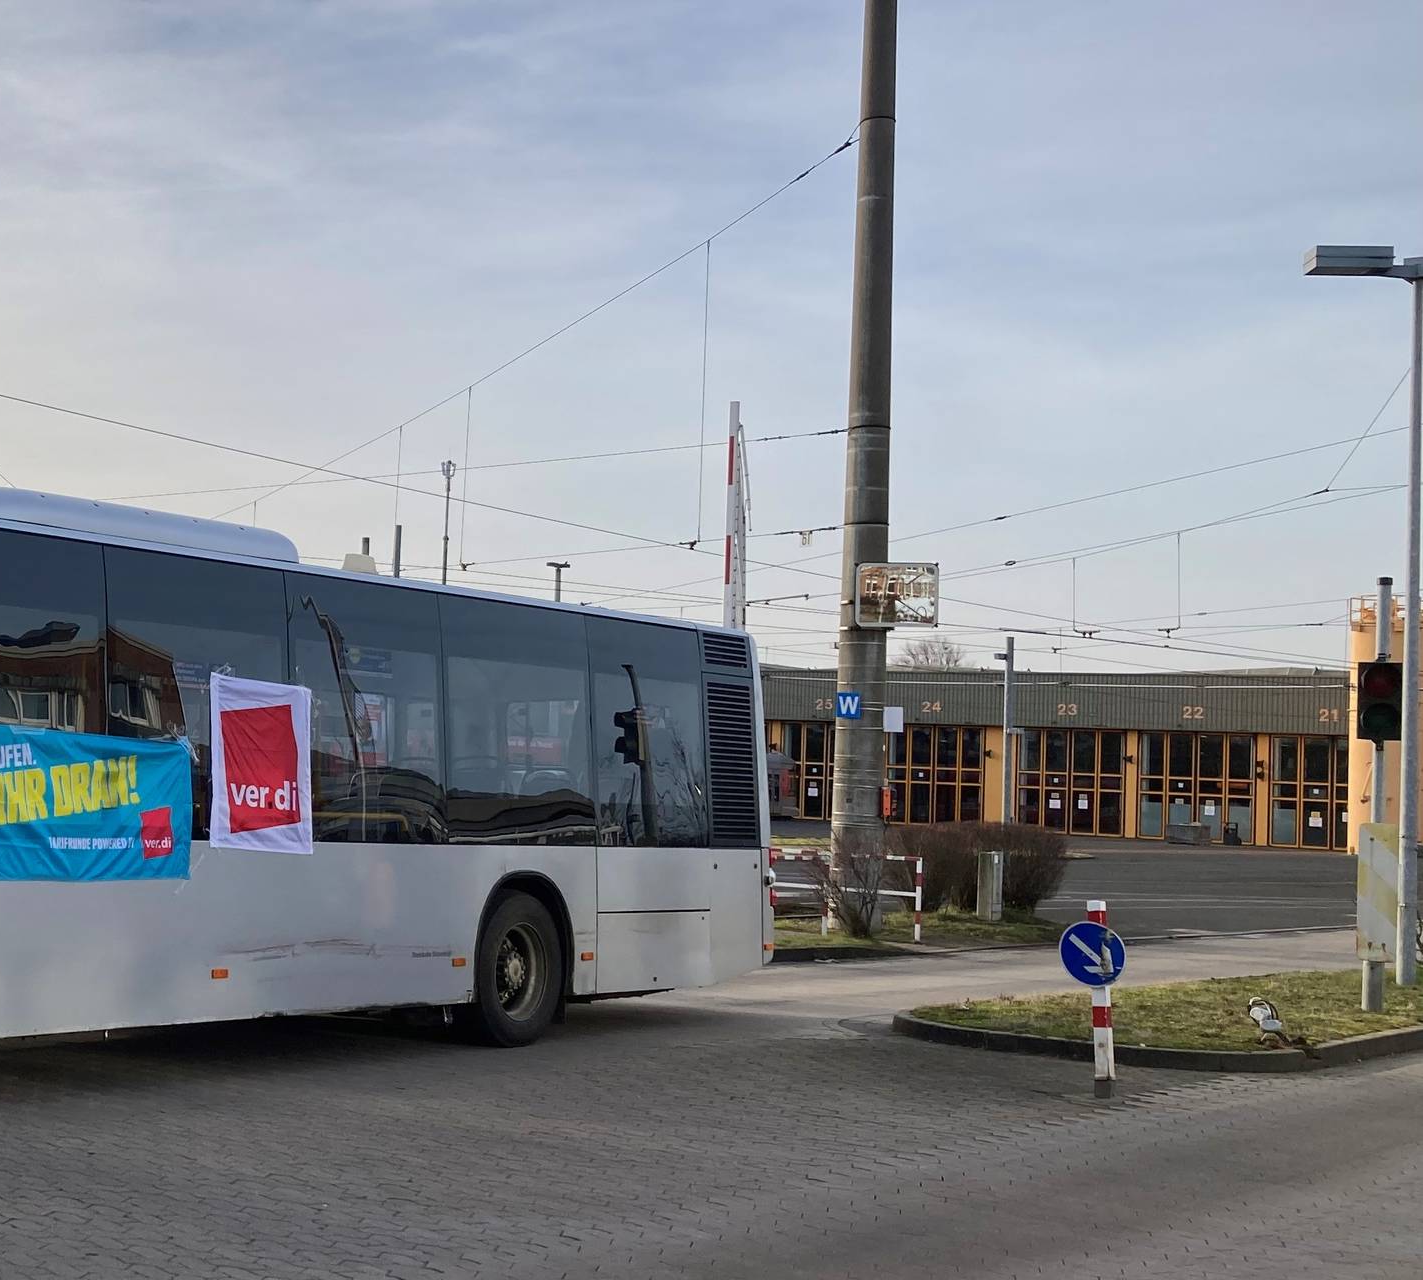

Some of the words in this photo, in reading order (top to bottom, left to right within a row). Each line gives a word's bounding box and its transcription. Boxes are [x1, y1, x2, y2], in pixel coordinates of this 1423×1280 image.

[815, 699, 833, 711] 25
[838, 695, 859, 715] W
[921, 701, 942, 713] 24
[1057, 704, 1077, 716] 23
[1183, 706, 1205, 719] 22
[1319, 709, 1340, 722] 21
[50, 755, 141, 817] DRAN!
[230, 780, 297, 812] ver.di
[92, 837, 127, 850] POWERED
[144, 836, 172, 849] ver.di
